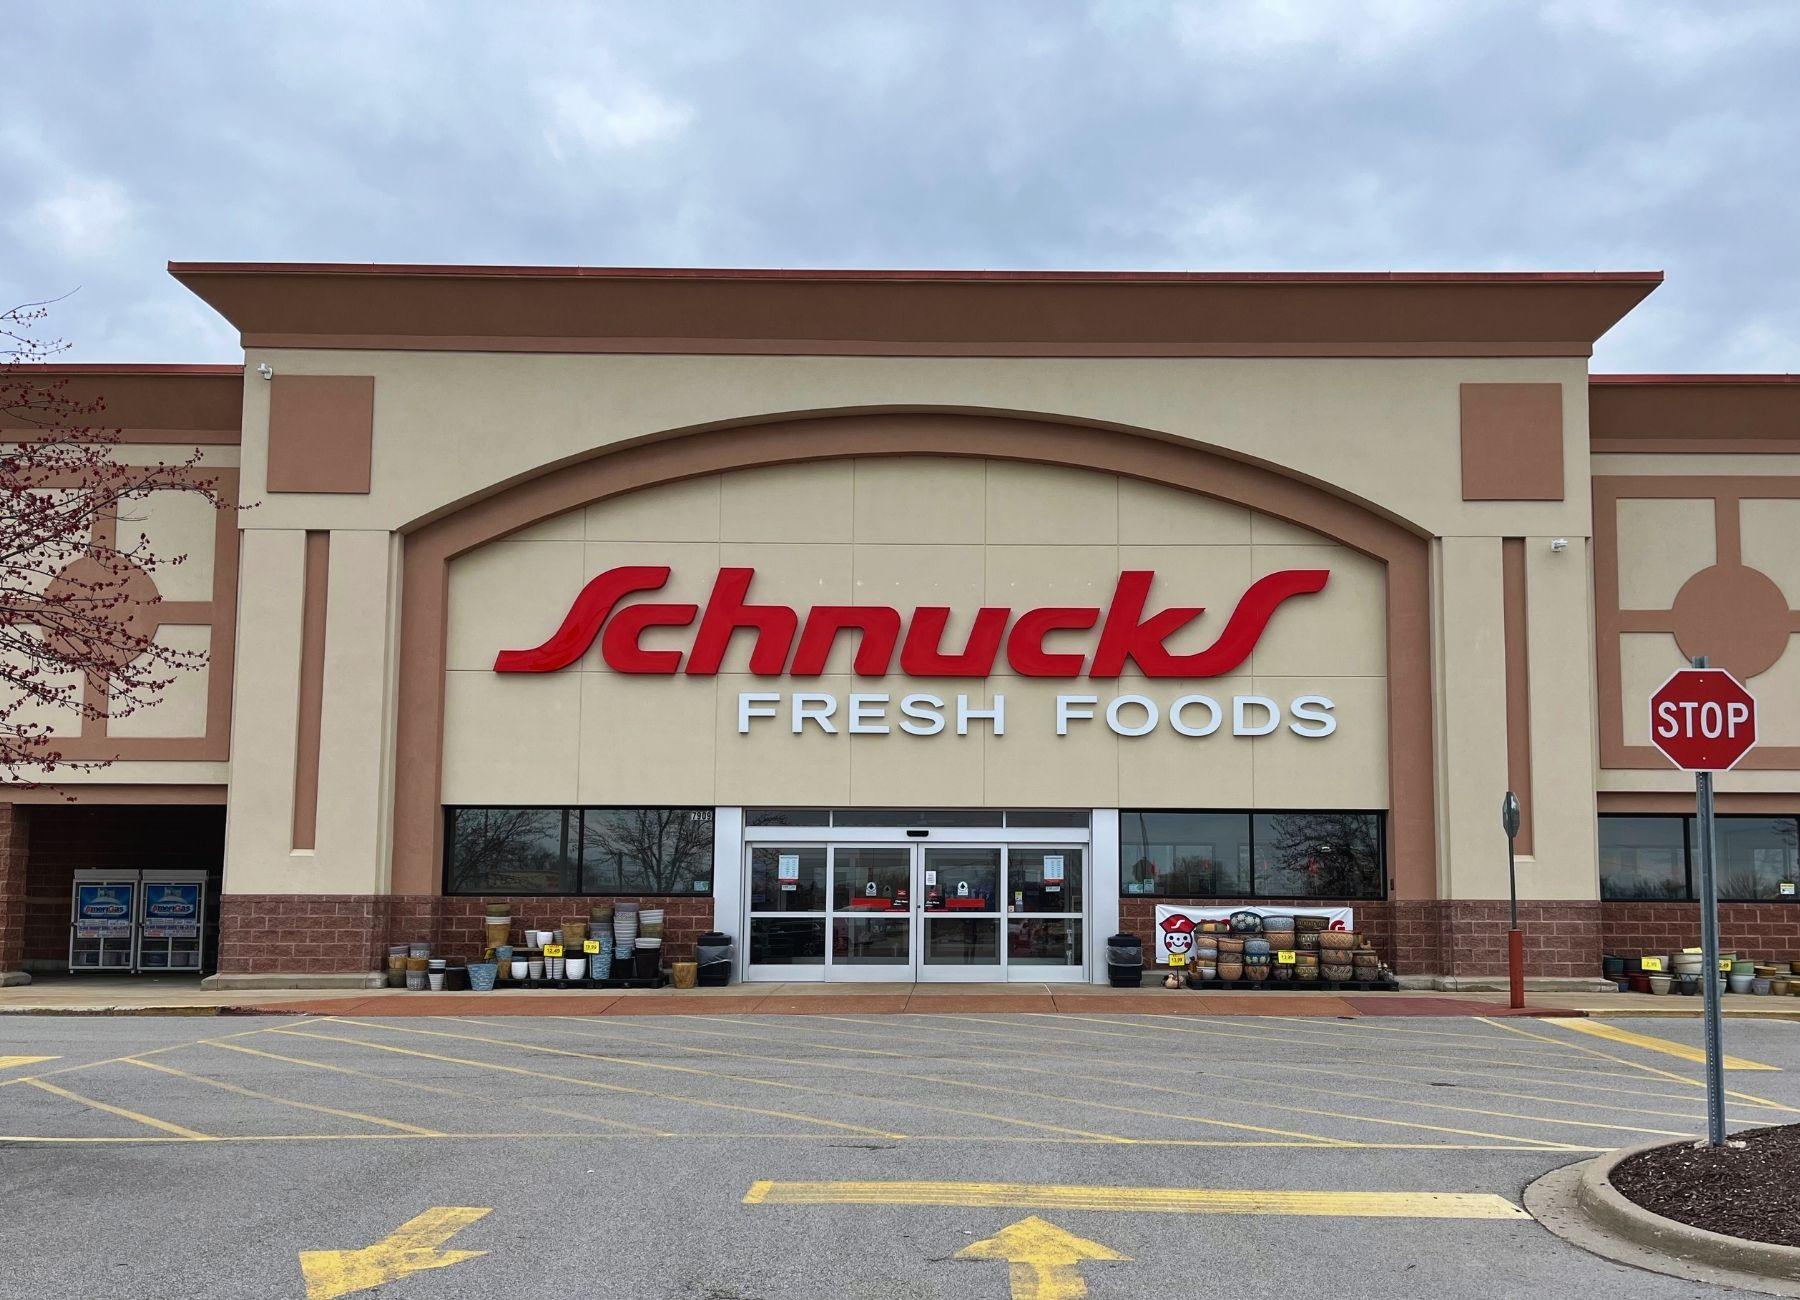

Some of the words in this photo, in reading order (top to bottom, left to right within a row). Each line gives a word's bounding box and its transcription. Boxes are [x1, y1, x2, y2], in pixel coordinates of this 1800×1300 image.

[493, 566, 1330, 677] Schnucks
[738, 692, 1005, 735] FRESH
[1056, 693, 1337, 738] FOODS
[1657, 701, 1749, 739] STOP
[691, 810, 712, 821] 7909
